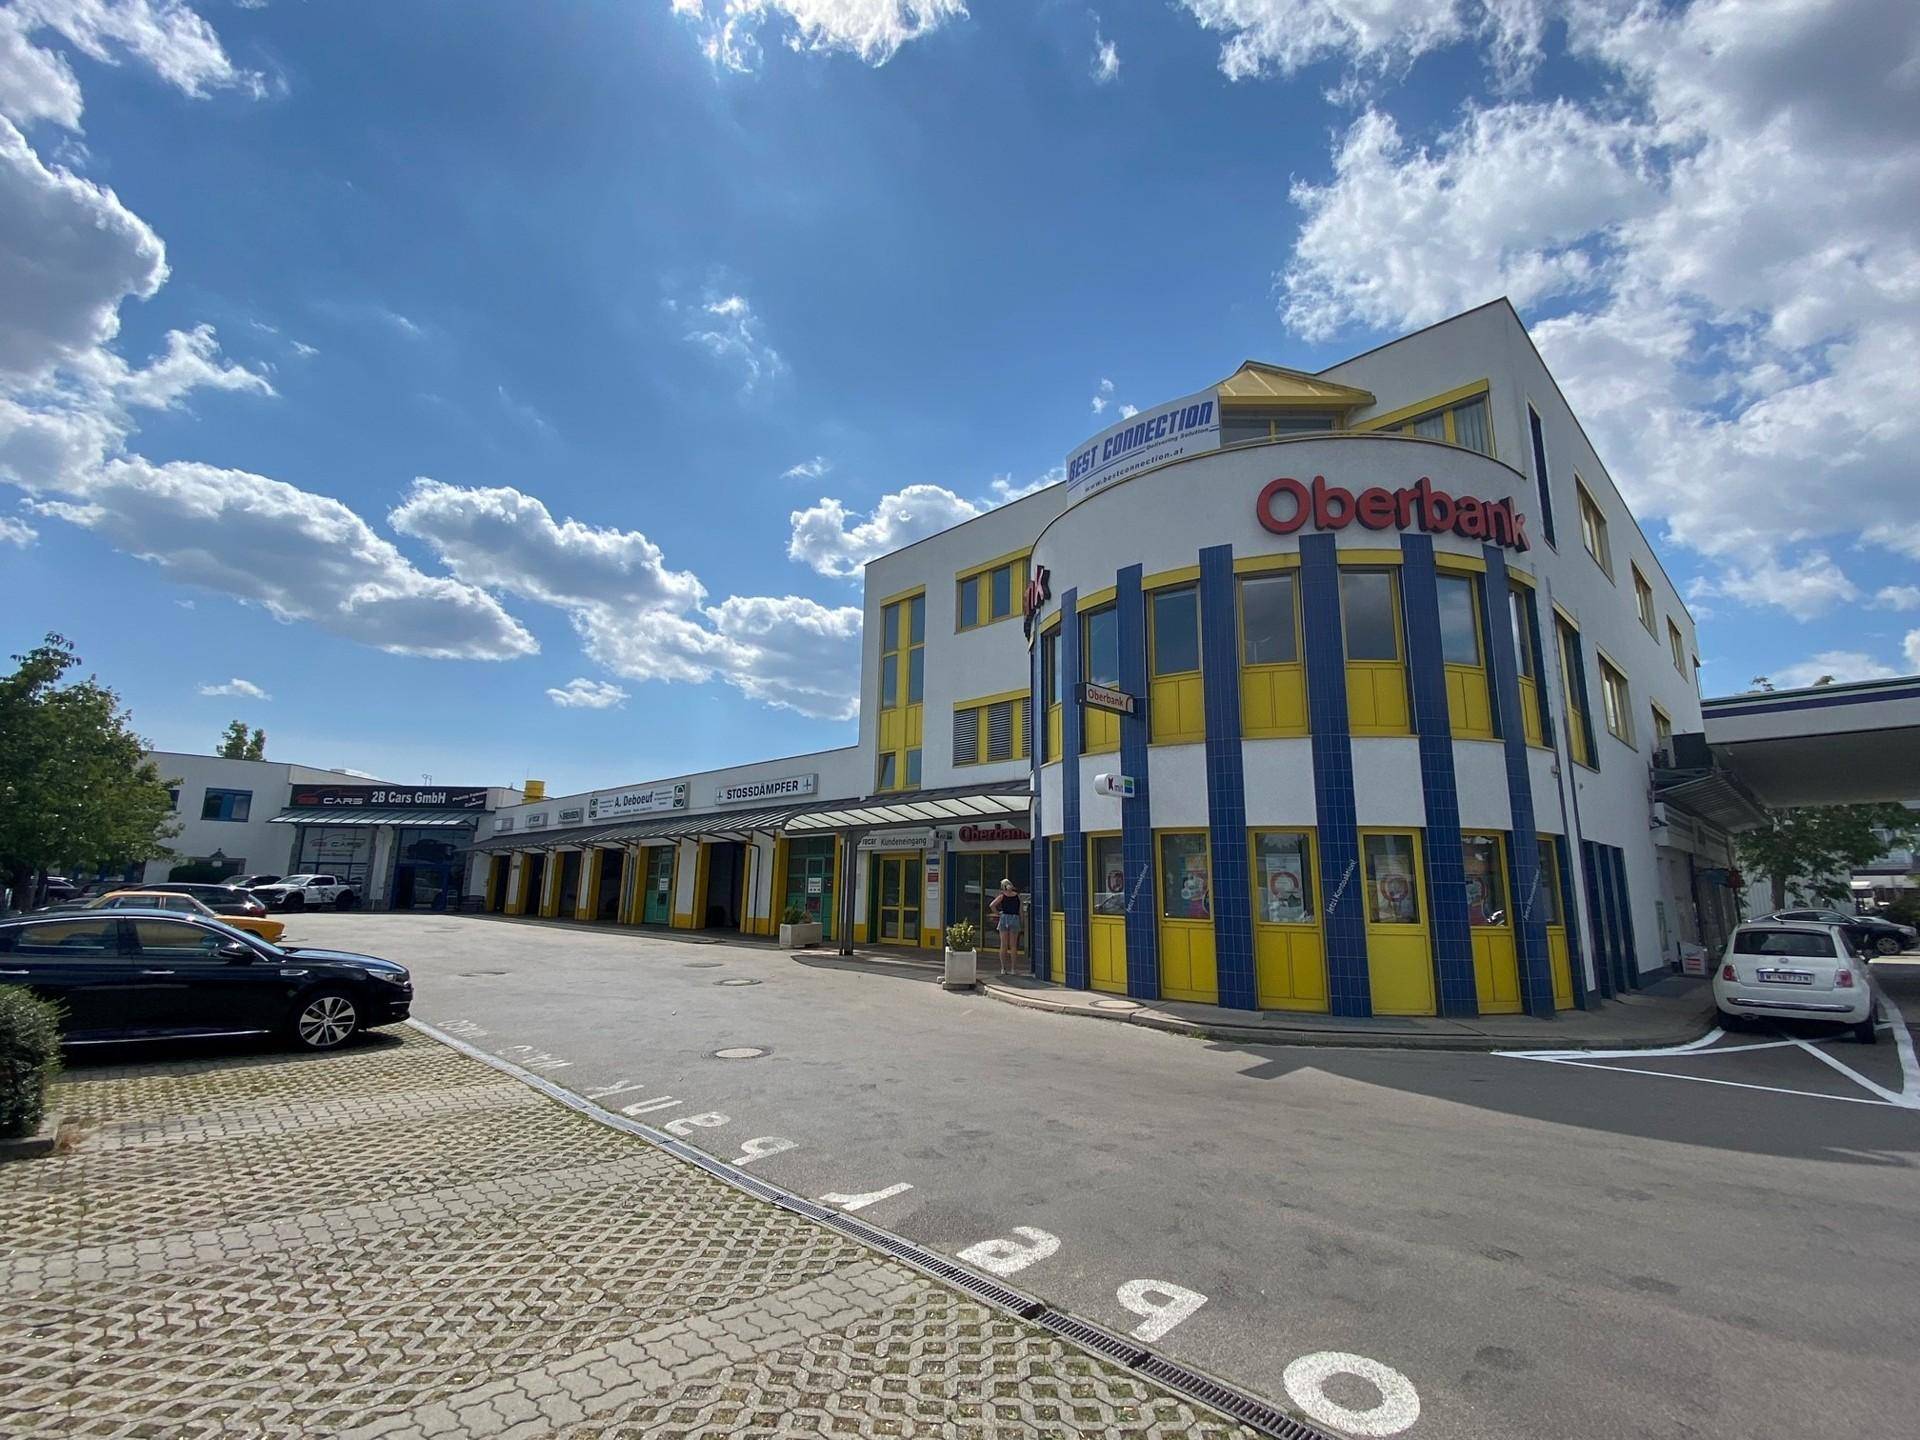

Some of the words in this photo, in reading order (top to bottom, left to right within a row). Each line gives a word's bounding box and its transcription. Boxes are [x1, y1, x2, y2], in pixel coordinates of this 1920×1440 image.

[1069, 445, 1098, 482] BEST
[1102, 401, 1213, 462] CONNECTION
[1085, 447, 1184, 492] www.bestconnection.at
[1256, 475, 1531, 552] Oberbank
[1088, 689, 1124, 706] Oberbank
[323, 797, 363, 805] CARS
[371, 791, 386, 803] 2B
[388, 791, 412, 804] Cars
[415, 792, 447, 804] GmbH
[726, 780, 799, 799] STOSSDÄMPFER
[585, 1079, 1421, 1437] Oberbank
